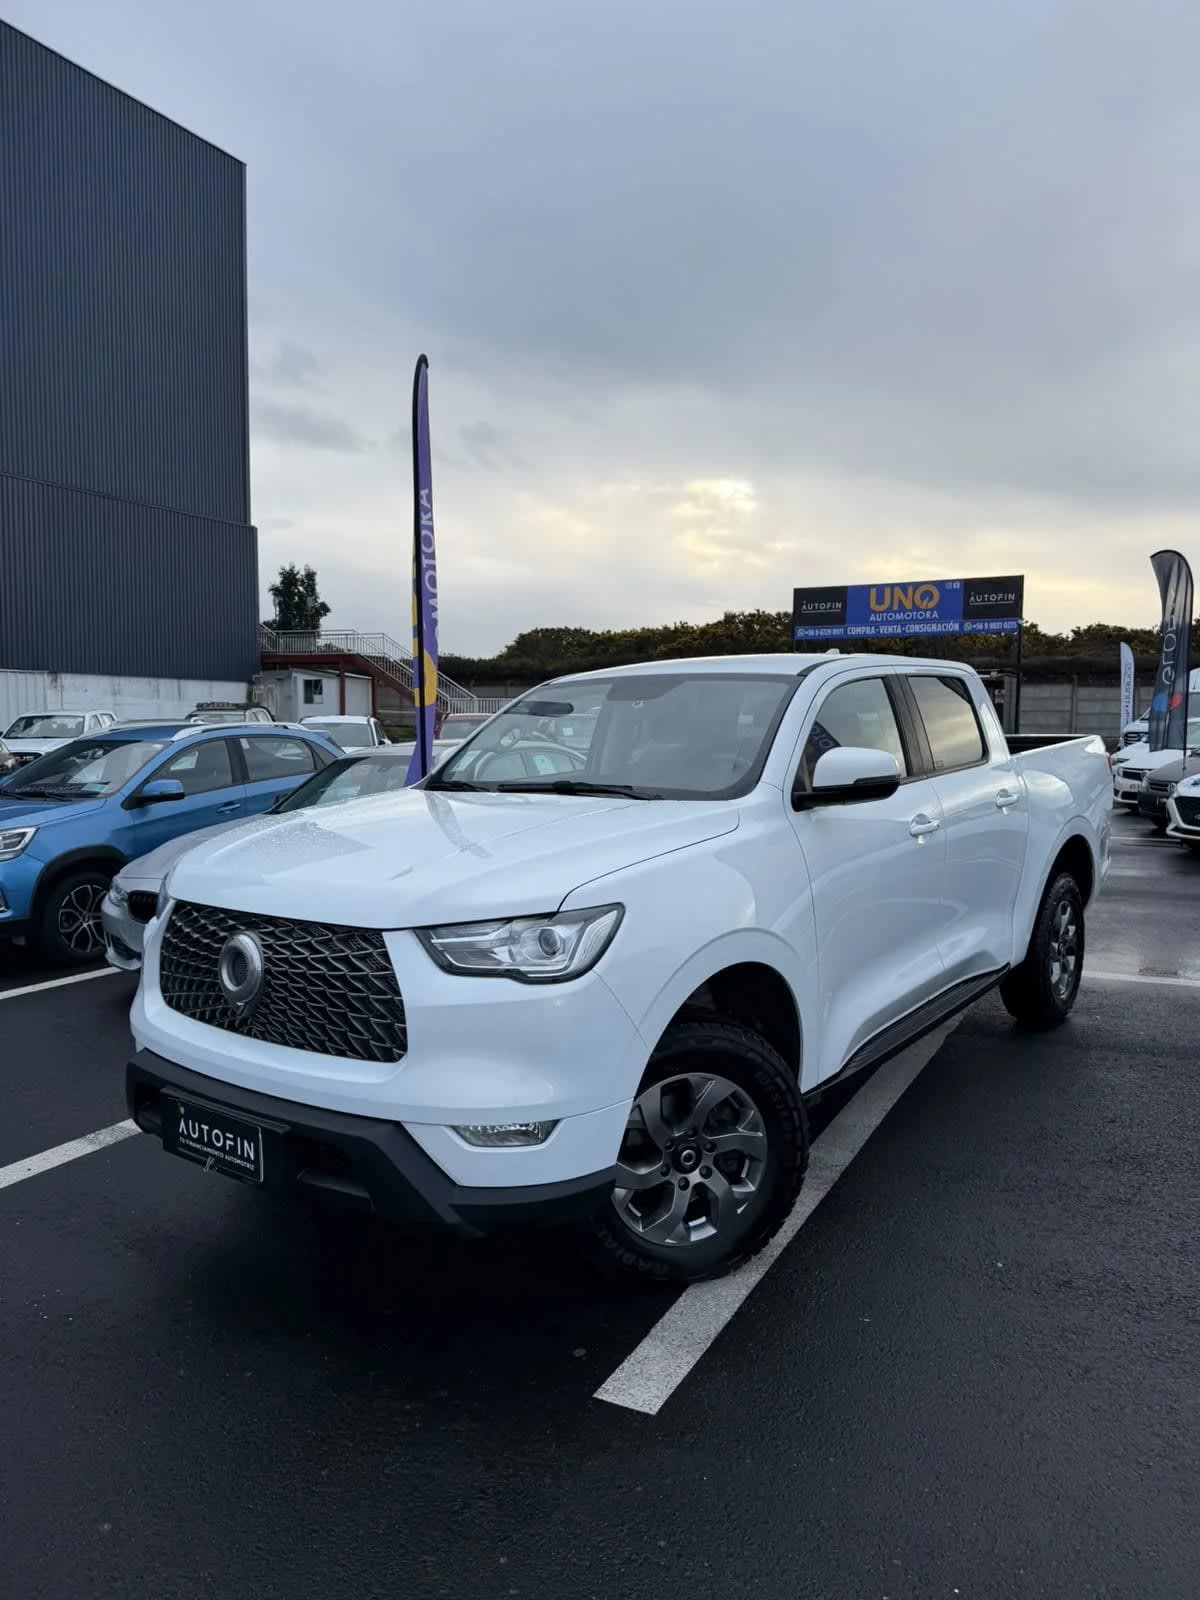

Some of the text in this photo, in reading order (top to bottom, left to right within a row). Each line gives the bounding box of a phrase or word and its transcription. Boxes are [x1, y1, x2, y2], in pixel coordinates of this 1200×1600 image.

[869, 584, 940, 612] UNO
[970, 592, 1015, 603] AUTOFIN
[802, 601, 842, 611] AUTOFIN
[869, 610, 939, 622] AUTOMOTORA
[847, 620, 960, 635] COMPRA VENTA CONSIGNACIÓN
[179, 1117, 255, 1161] AUTOFIN
